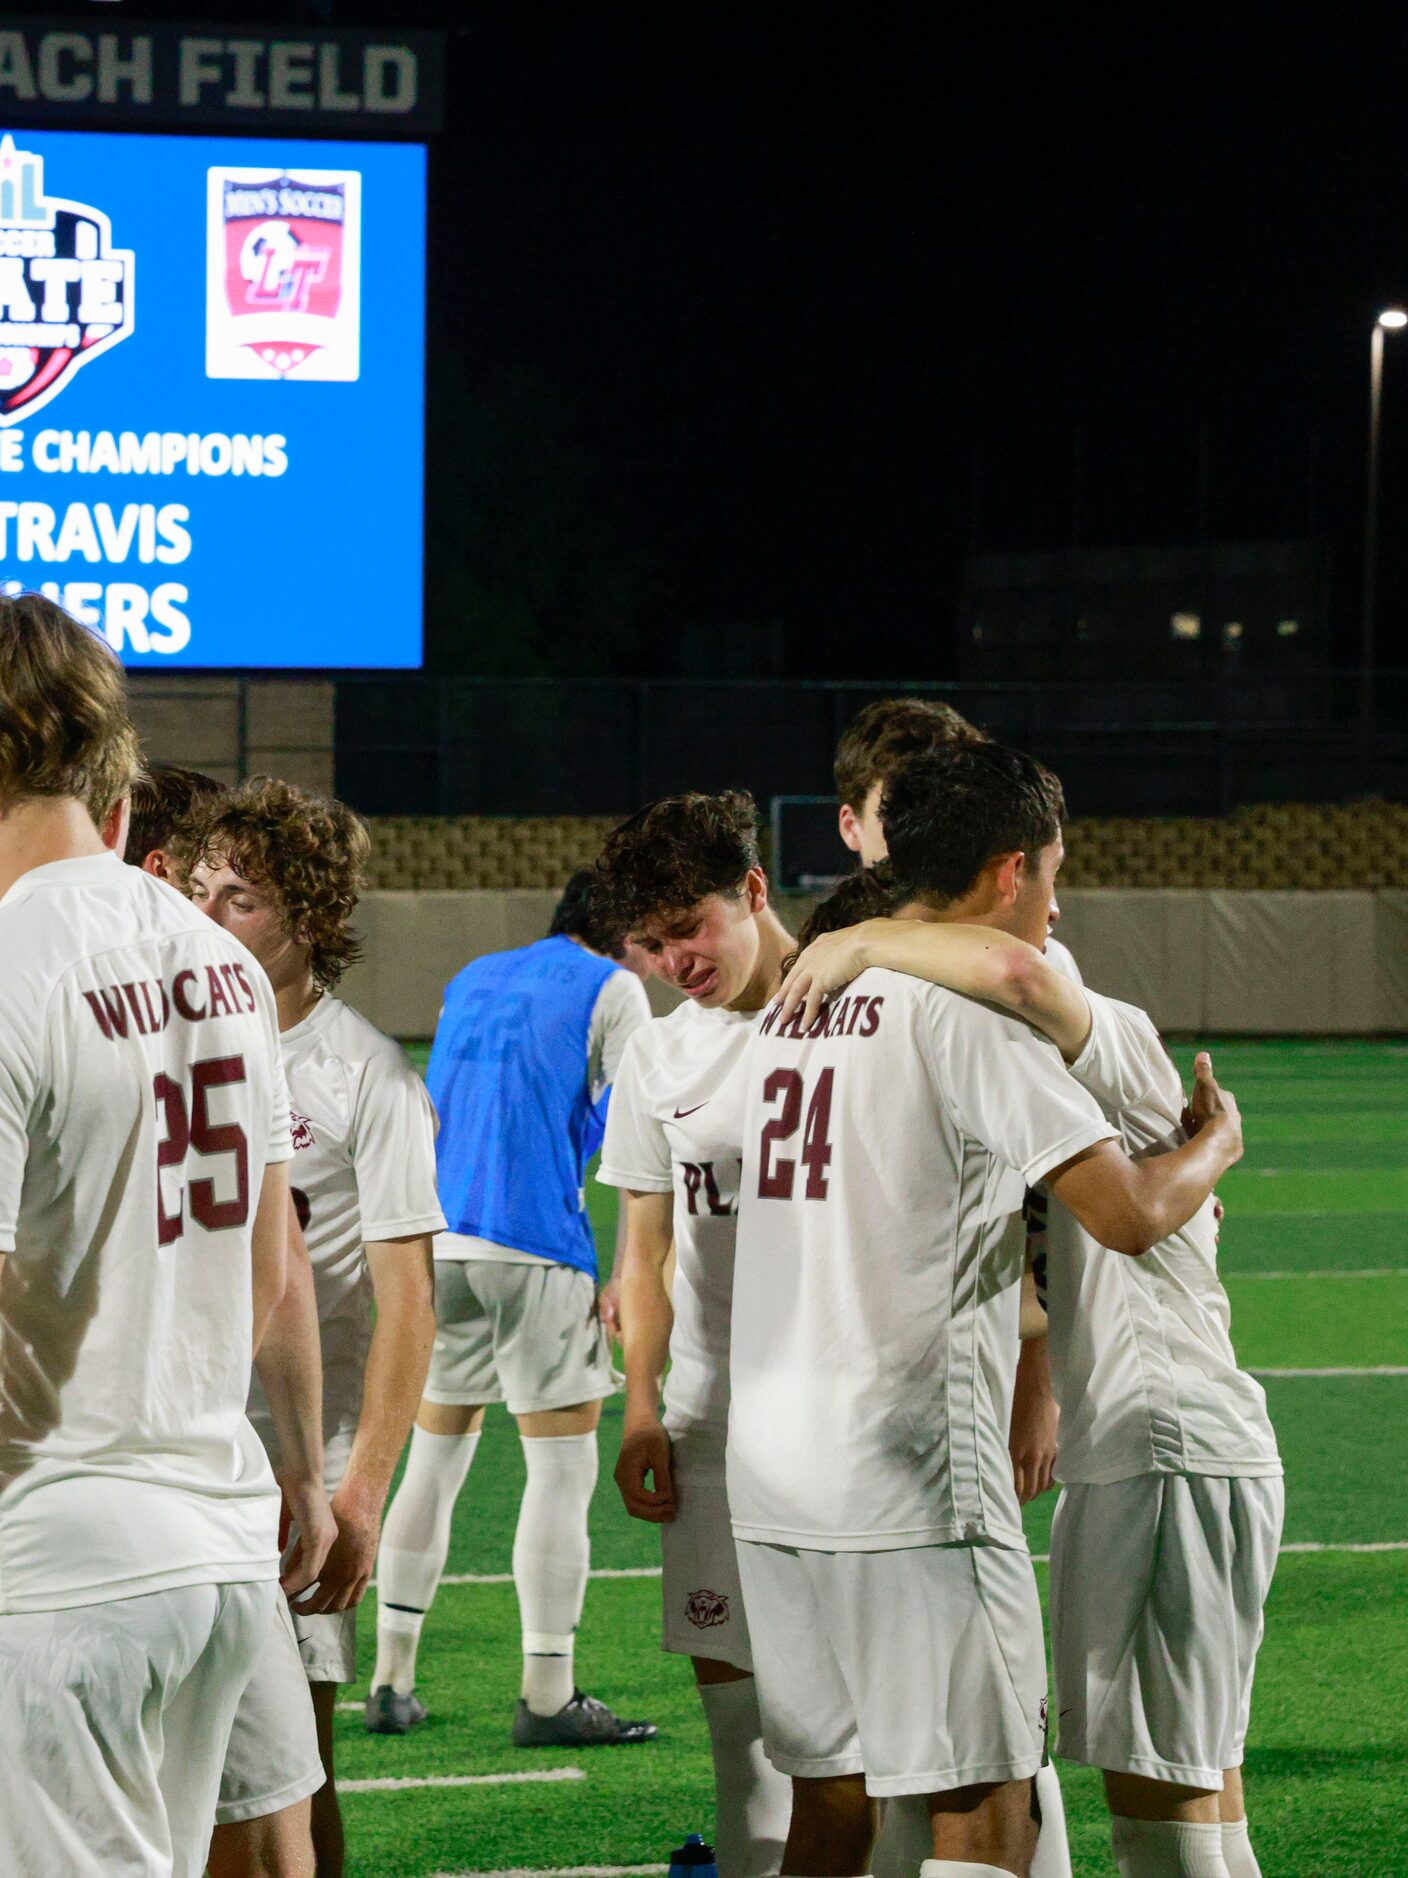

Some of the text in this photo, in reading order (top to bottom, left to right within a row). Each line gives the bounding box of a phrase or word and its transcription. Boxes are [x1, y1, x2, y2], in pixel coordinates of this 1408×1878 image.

[180, 38, 417, 112] FIELD
[33, 429, 288, 477] CHAMPIONS
[152, 1053, 249, 1248] 25
[757, 1066, 835, 1201] 24
[679, 1156, 742, 1216] PL
